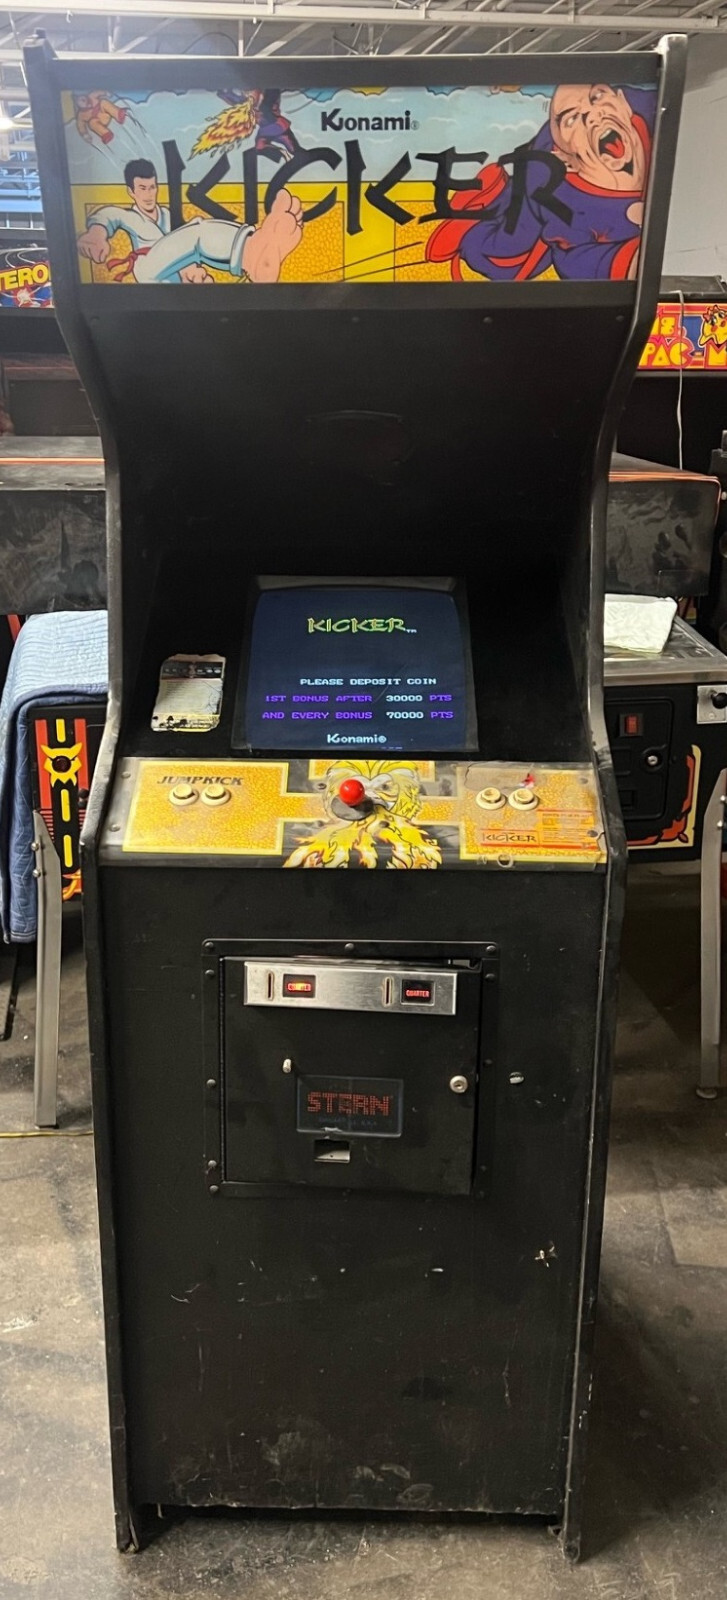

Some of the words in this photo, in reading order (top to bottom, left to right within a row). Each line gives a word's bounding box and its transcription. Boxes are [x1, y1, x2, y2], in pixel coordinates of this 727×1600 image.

[321, 108, 411, 132] Konami
[162, 139, 574, 235] KICKER
[307, 617, 406, 633] KICKER
[300, 678, 344, 686] PLEASE
[350, 678, 401, 686] DEPOSIT
[265, 695, 287, 703] 1ST
[292, 695, 329, 703] BONUS
[336, 695, 372, 703] AFTER
[386, 694, 423, 702] 30000
[429, 694, 452, 702] PTS
[262, 711, 285, 720] AND
[291, 711, 329, 720] EVERY
[335, 711, 373, 720] BONUS
[386, 711, 424, 720] 70000
[430, 711, 454, 719] PTS
[157, 776, 244, 786] JUMPKICK
[482, 831, 537, 843] KICKER
[405, 989, 430, 998] QUARTER
[307, 1091, 390, 1117] STERN
